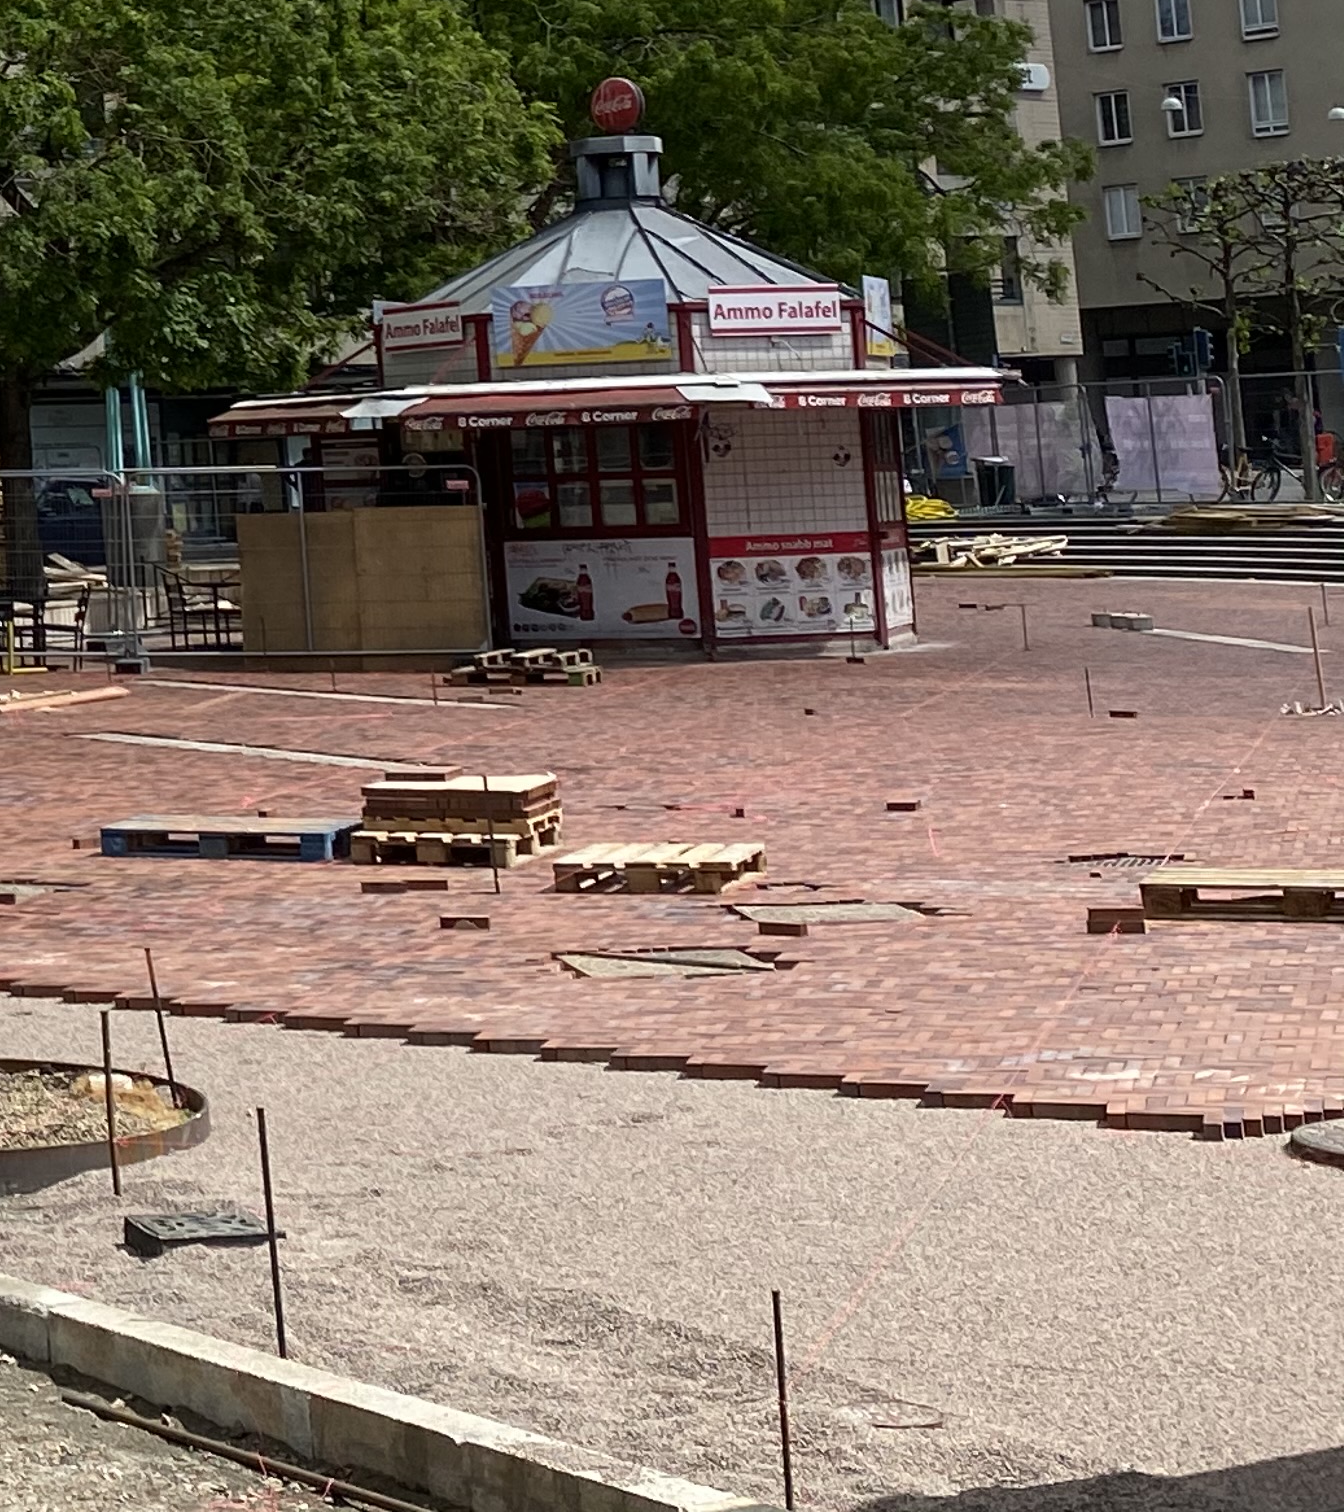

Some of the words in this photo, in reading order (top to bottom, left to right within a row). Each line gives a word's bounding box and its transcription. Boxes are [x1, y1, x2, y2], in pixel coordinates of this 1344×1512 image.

[713, 303, 773, 321] Ammo
[777, 300, 837, 320] Falafel
[385, 322, 421, 340] Ammo
[422, 314, 460, 336] Falafel
[808, 394, 847, 407] Corner
[912, 391, 951, 405] Corner
[468, 415, 514, 428] Corner
[592, 410, 639, 422] Corner
[745, 540, 780, 552] Ammo
